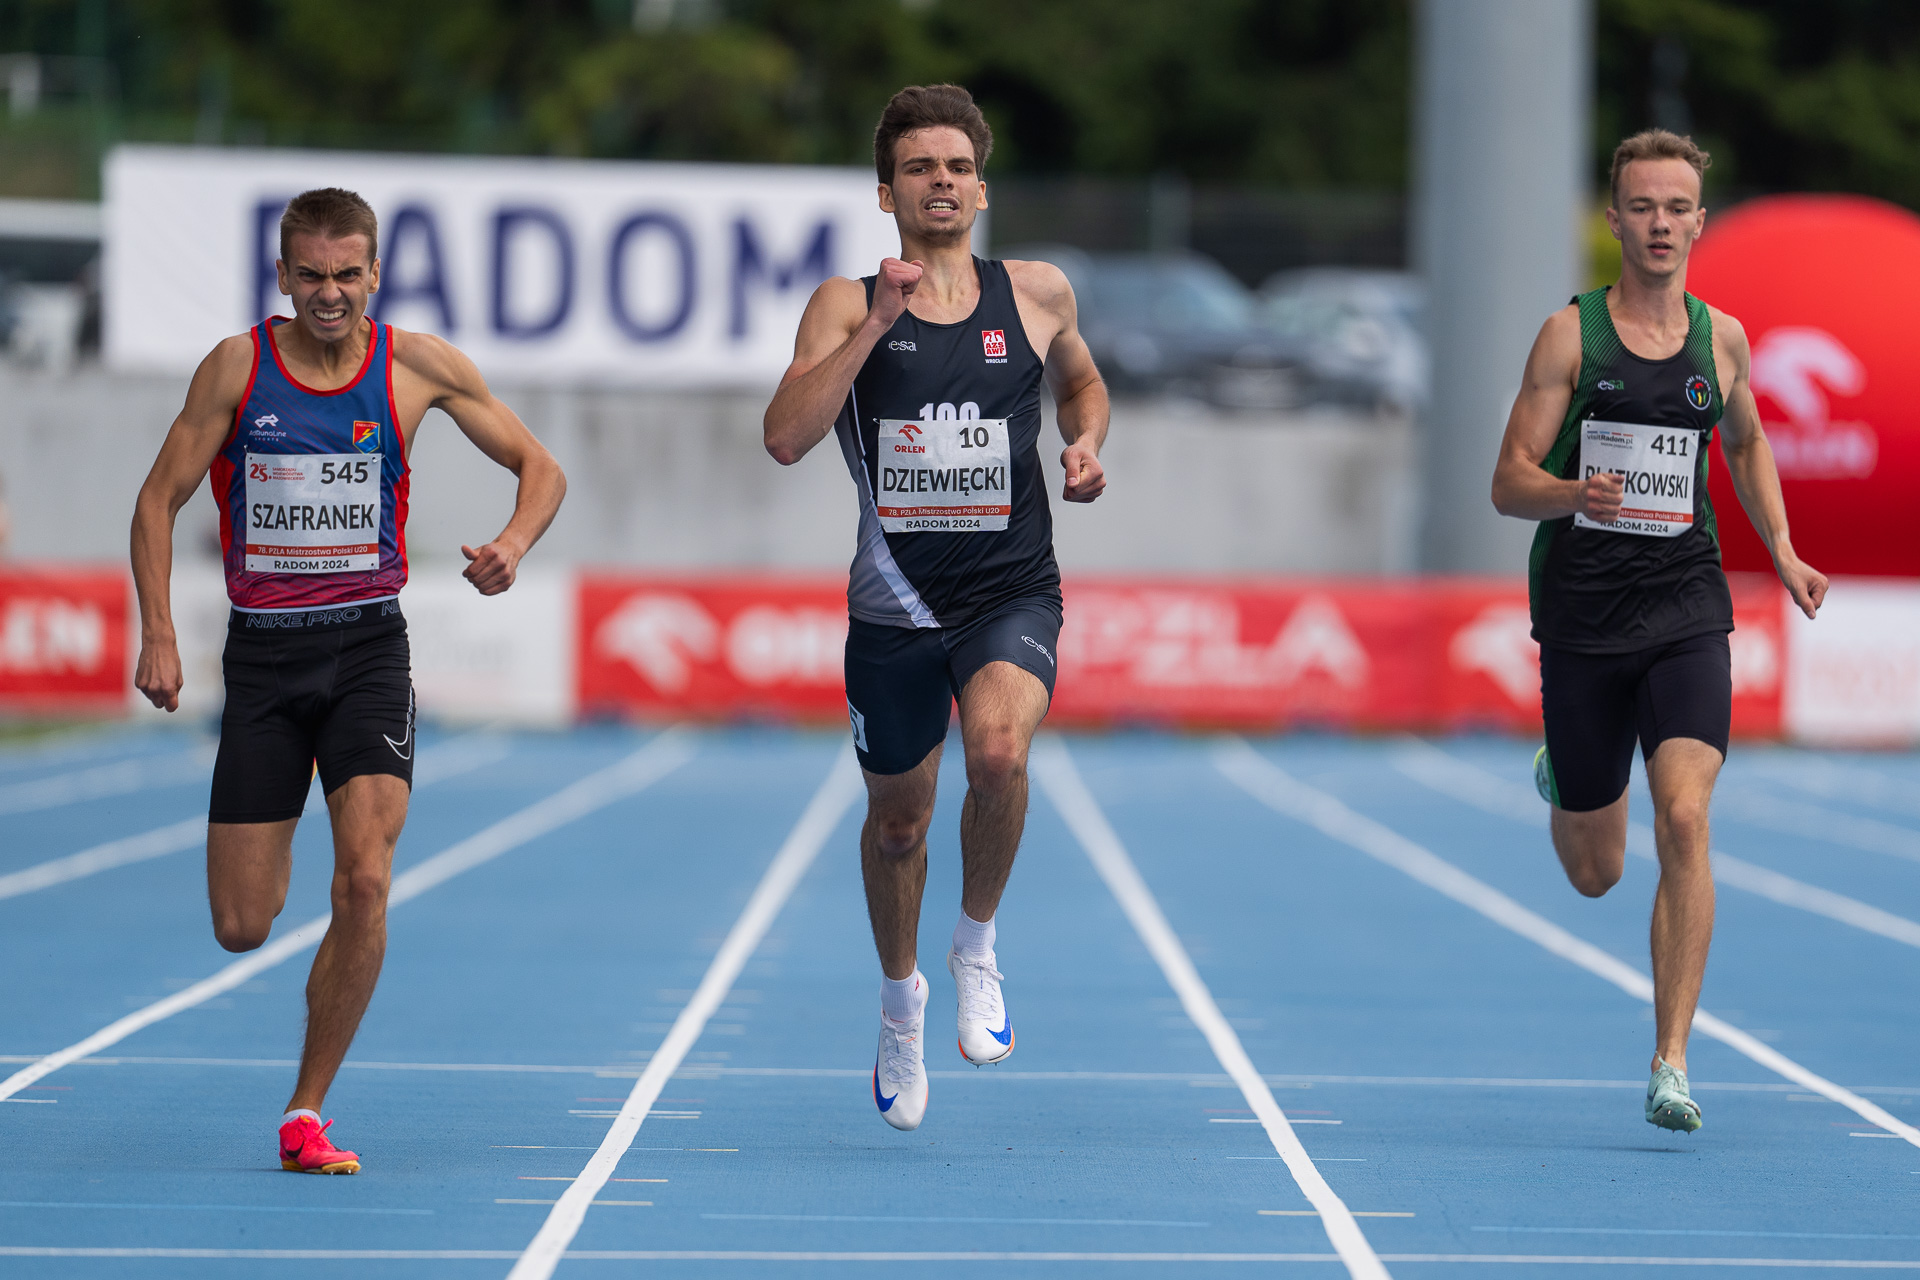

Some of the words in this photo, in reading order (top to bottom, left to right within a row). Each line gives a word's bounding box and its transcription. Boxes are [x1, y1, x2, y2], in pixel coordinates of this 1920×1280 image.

[985, 341, 1004, 349] AZS
[1597, 379, 1624, 391] esa
[959, 426, 990, 449] 10
[894, 444, 926, 454] ORLEN
[1650, 434, 1688, 457] 411
[320, 461, 368, 484] 545
[882, 466, 1006, 496] DZIEWIĘCKI
[1585, 464, 1689, 499] PKOWSKI
[918, 507, 962, 515] Mistrzostwa
[962, 506, 984, 514] Polski
[1654, 512, 1672, 520] Polski
[252, 503, 375, 530] SZAFRANEK
[906, 520, 950, 529] RADOM
[952, 519, 981, 528] 2024
[1643, 522, 1669, 533] 2024
[268, 547, 285, 555] PZLA
[286, 547, 332, 556] Mistrzostwa
[332, 547, 353, 555] Polski
[354, 545, 368, 553] U20
[274, 560, 319, 570] RADOM
[321, 559, 350, 569] 2024
[246, 612, 305, 628] NIKE
[307, 607, 362, 626] PRO
